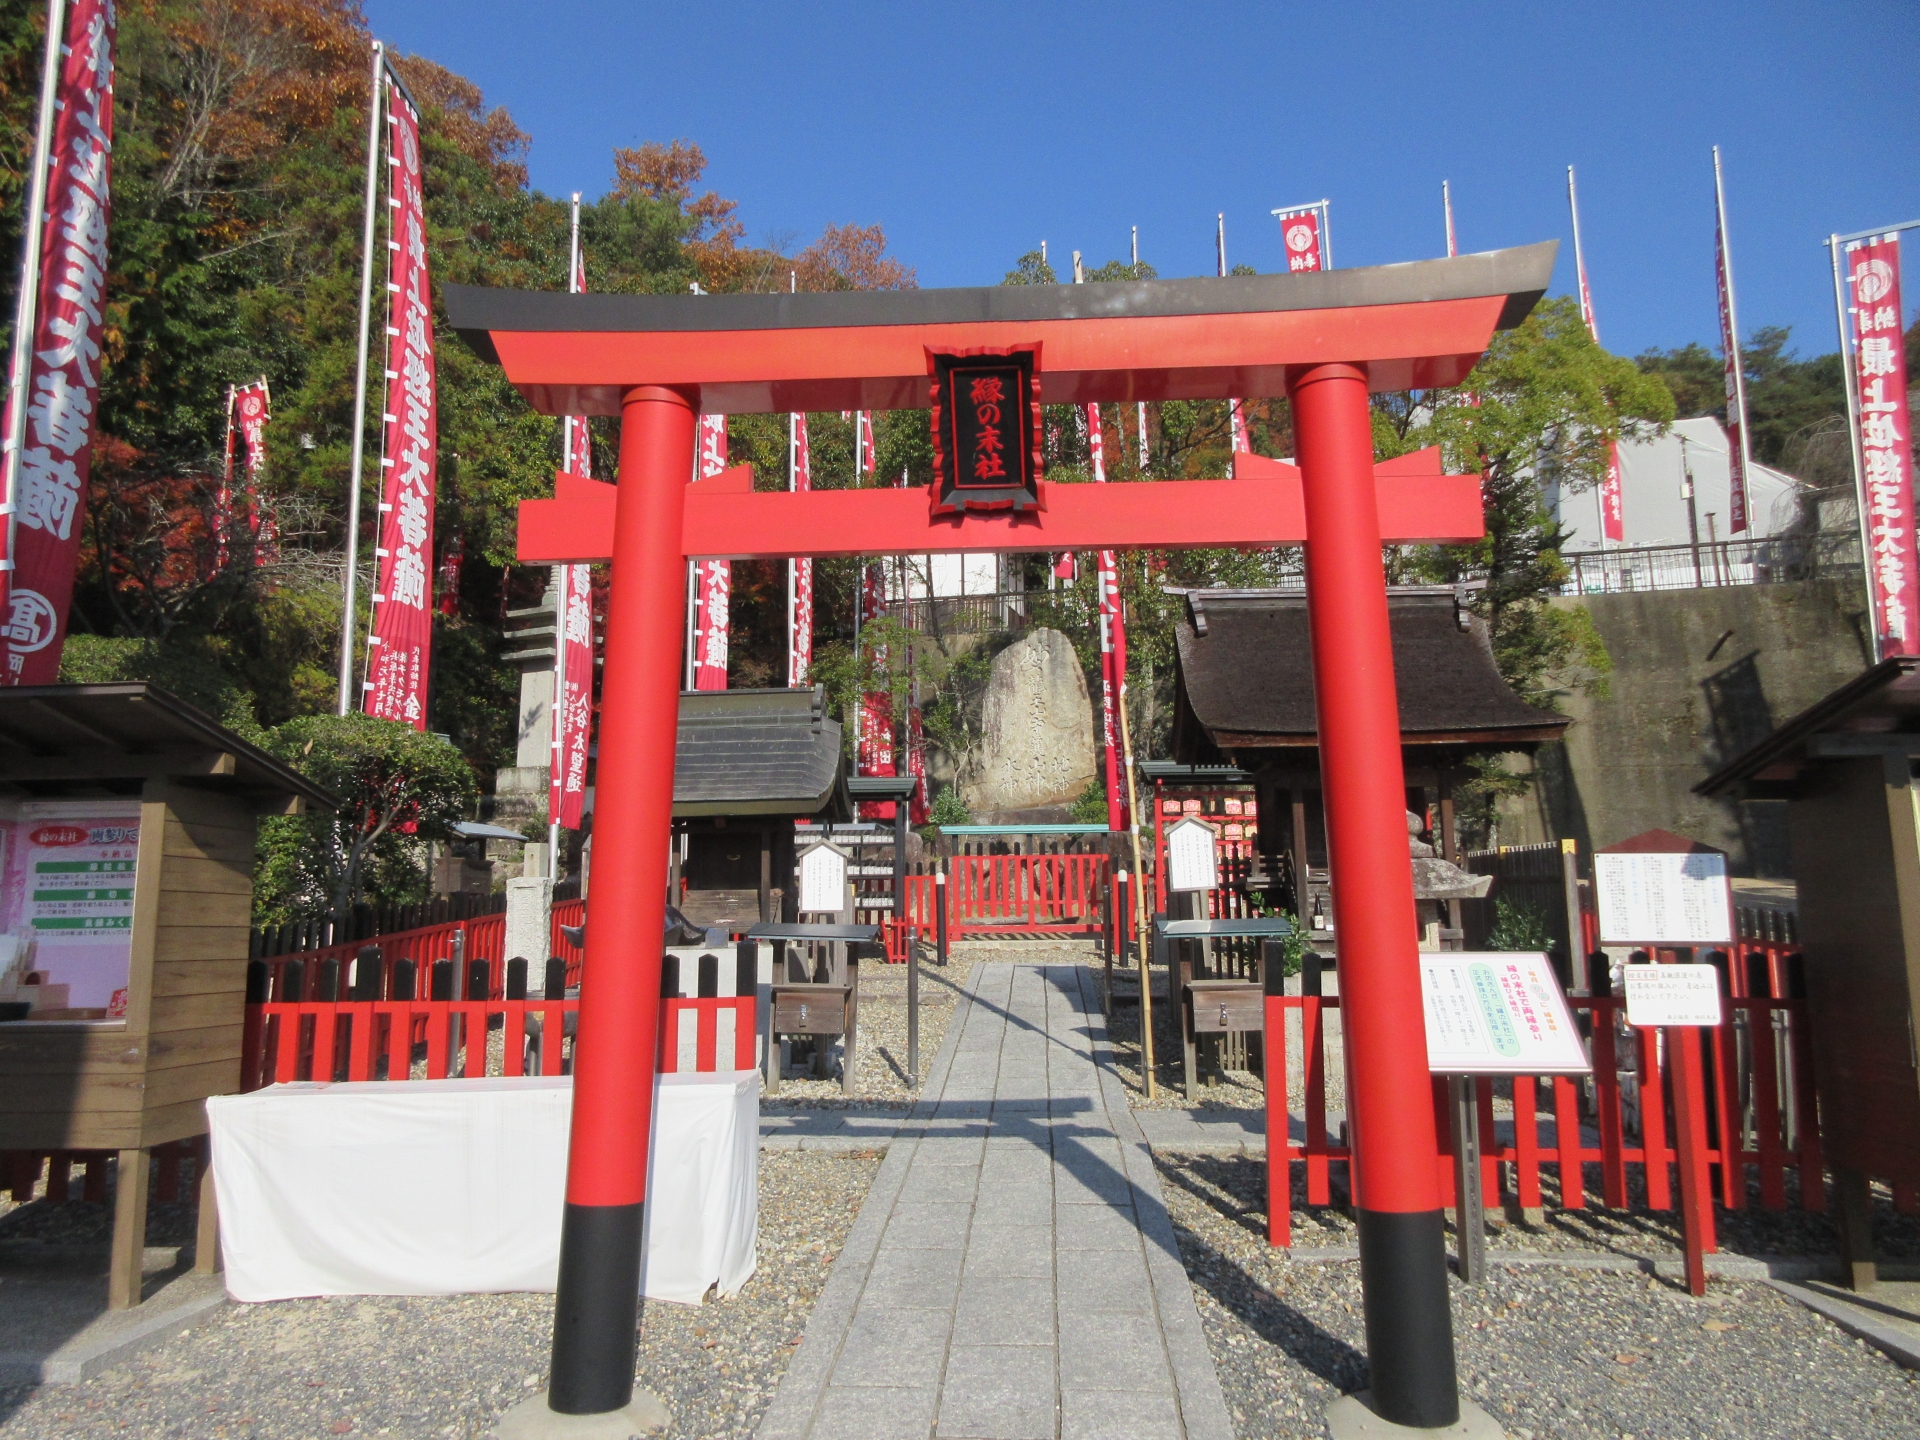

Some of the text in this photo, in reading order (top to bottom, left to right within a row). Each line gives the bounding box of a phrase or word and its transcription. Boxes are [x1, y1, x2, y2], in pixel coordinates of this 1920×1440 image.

[1290, 253, 1316, 271] 奉納
[970, 377, 1006, 480] 縁の末社
